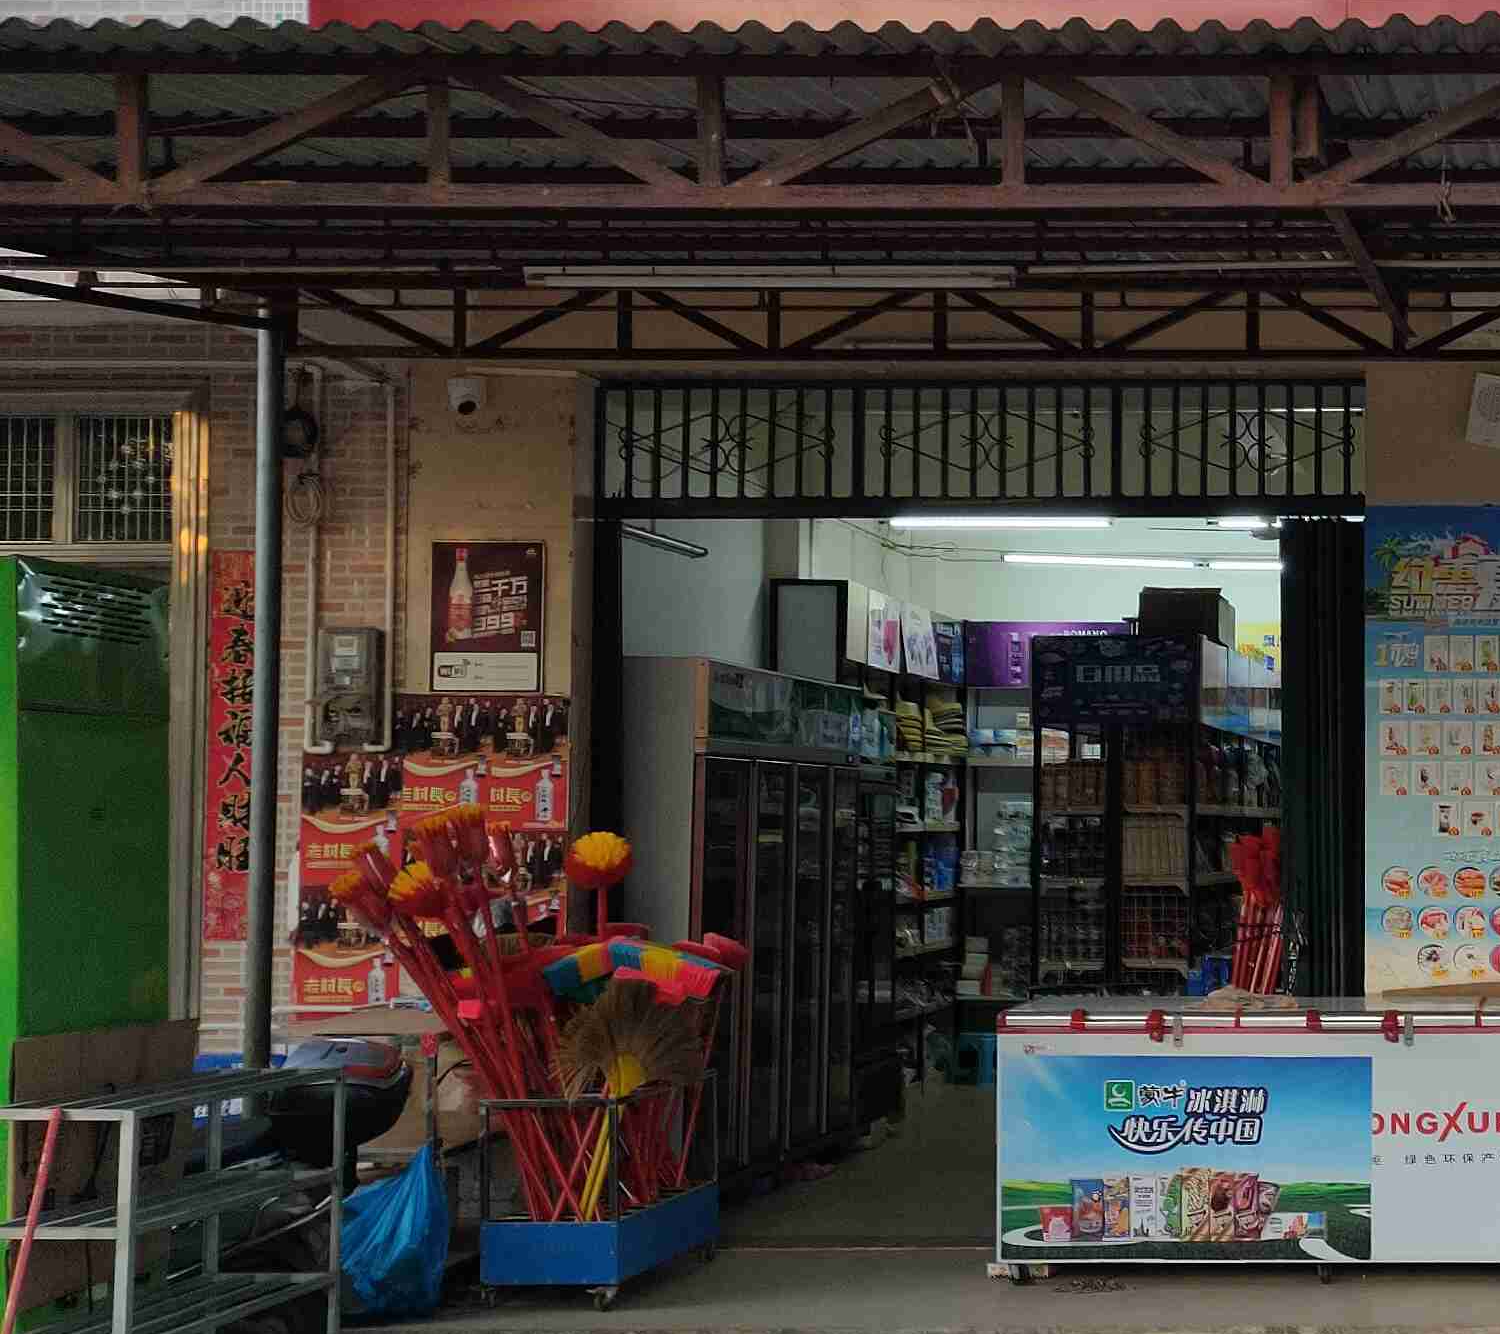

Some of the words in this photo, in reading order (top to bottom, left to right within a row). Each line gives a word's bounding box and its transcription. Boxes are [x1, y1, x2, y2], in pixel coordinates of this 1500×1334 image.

[1137, 1083, 1184, 1109] 蒙牛
[1185, 1087, 1268, 1116] 冰淇淋
[1112, 1116, 1263, 1149] 快乐传中国
